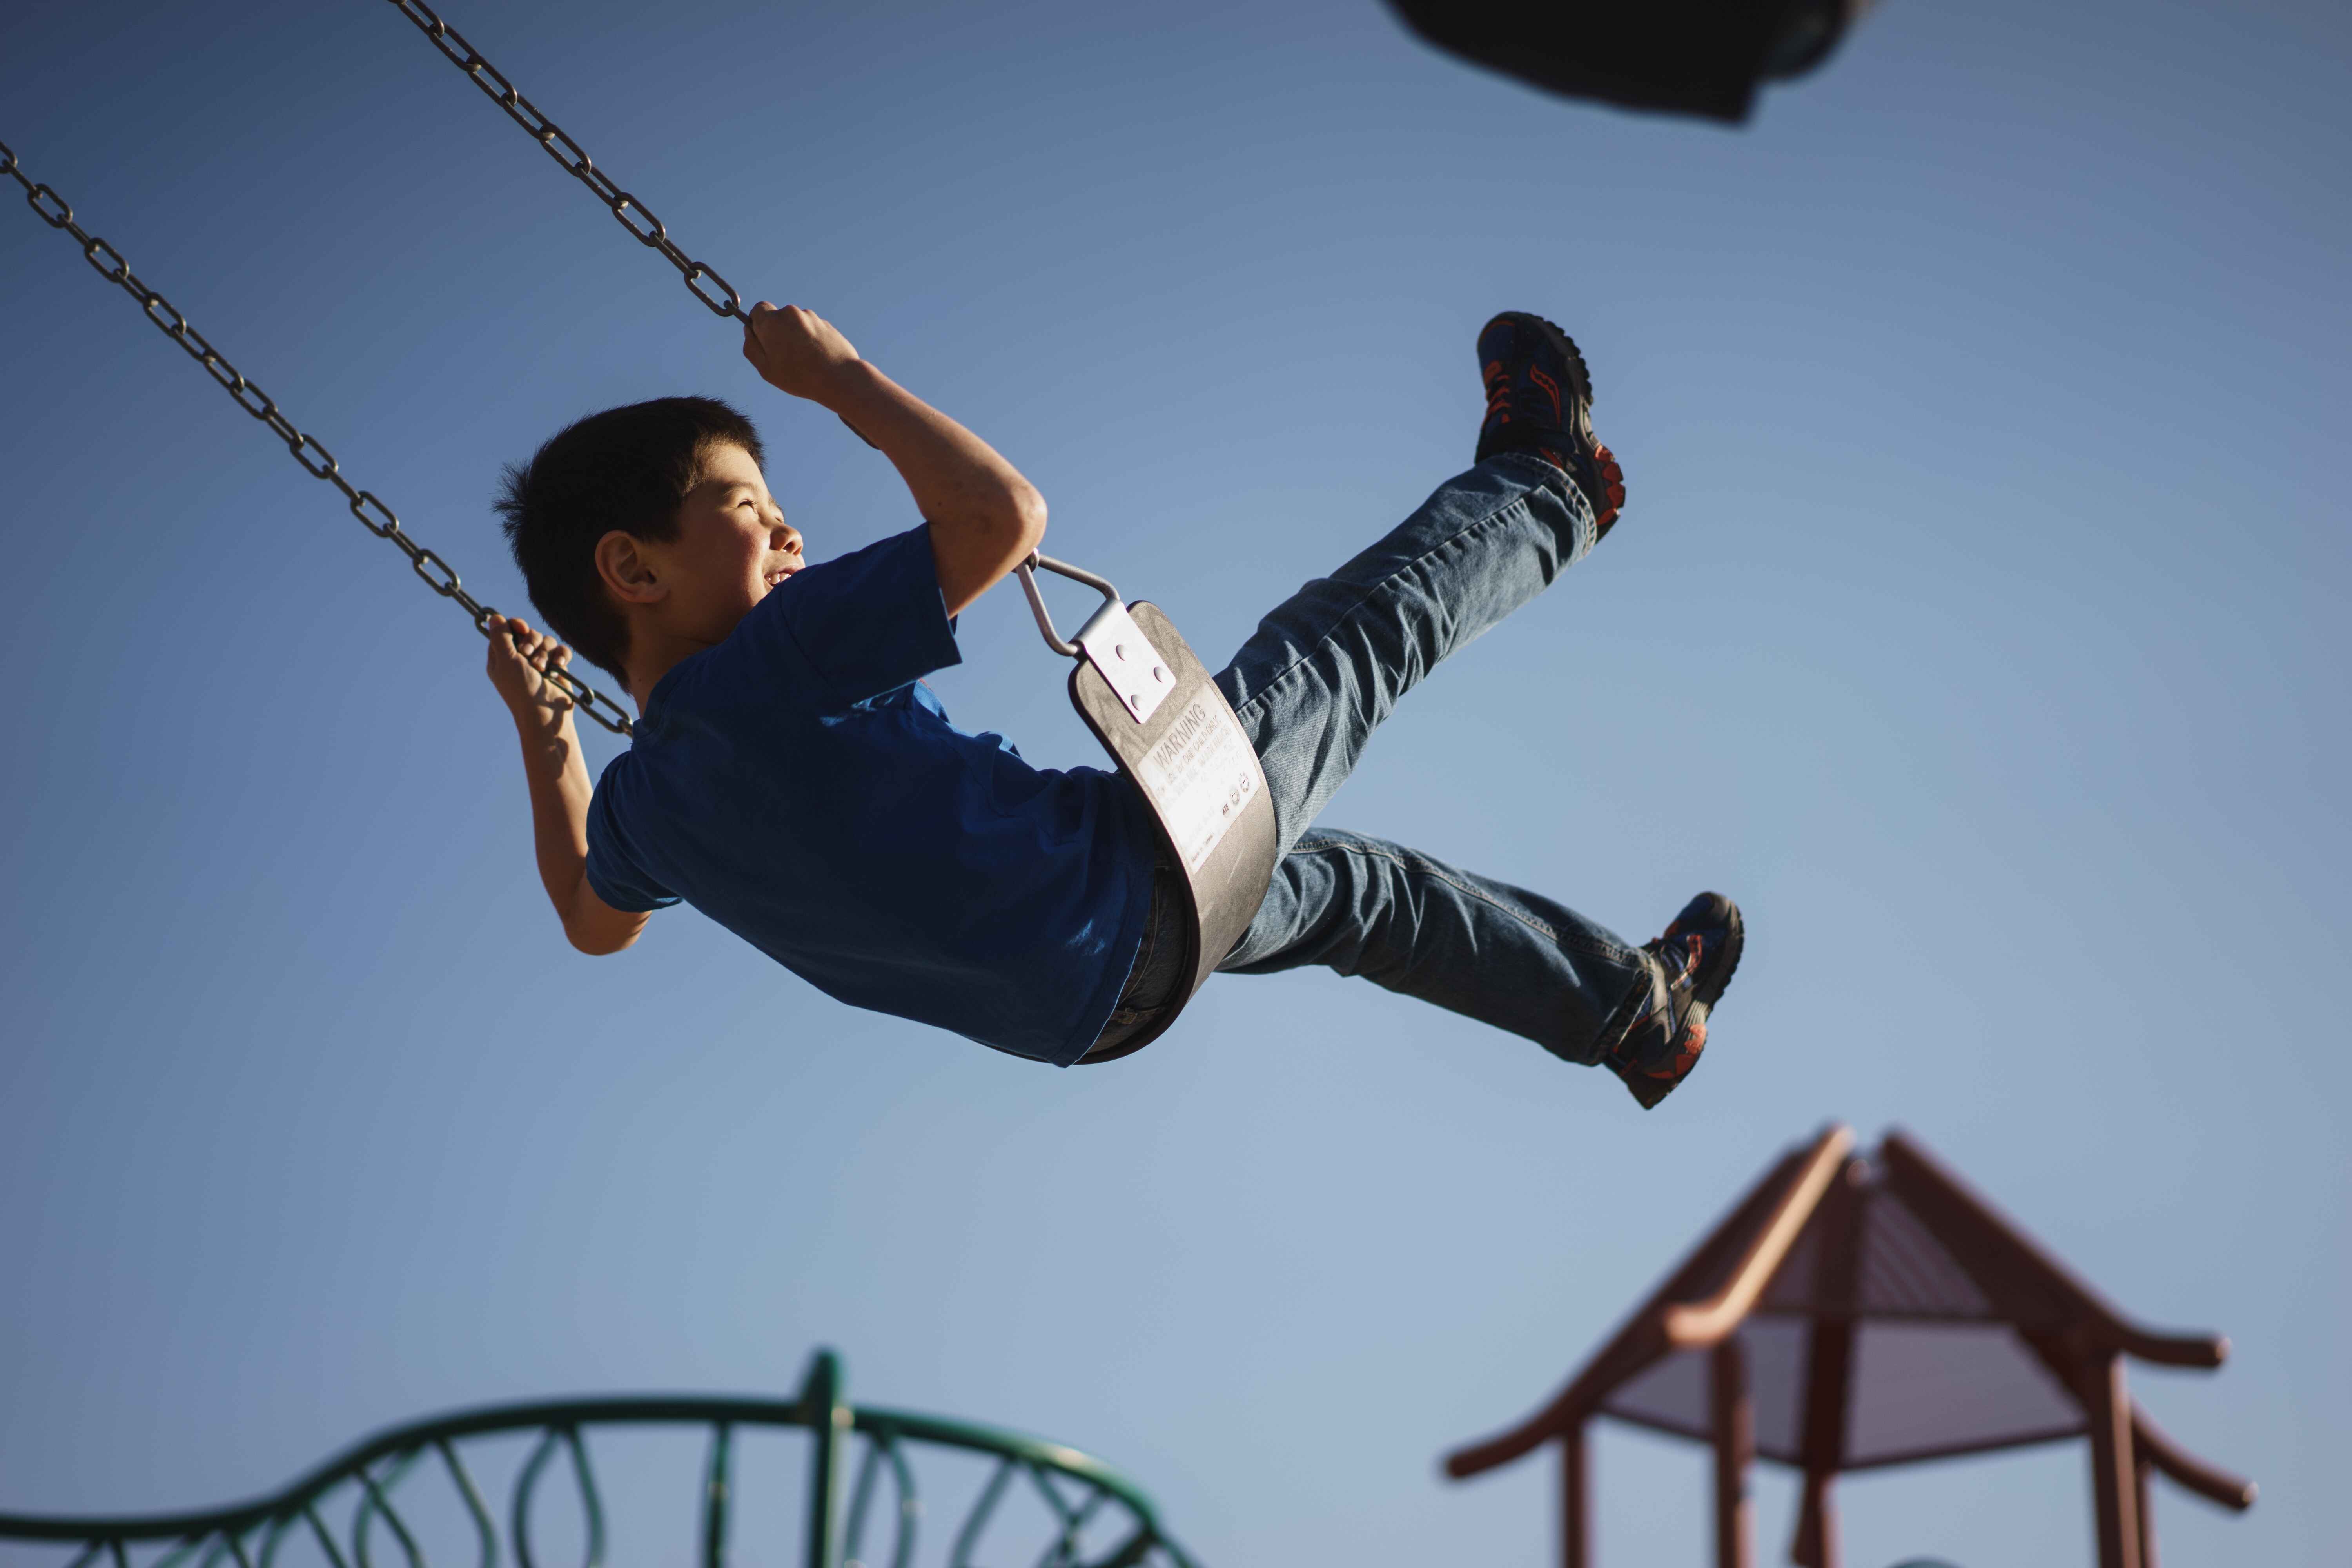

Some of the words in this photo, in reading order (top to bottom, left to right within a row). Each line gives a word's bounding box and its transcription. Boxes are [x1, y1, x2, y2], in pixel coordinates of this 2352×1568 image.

[1153, 704, 1205, 769] WARNING
[1183, 747, 1195, 764] ONE
[1193, 730, 1209, 752] CHILD
